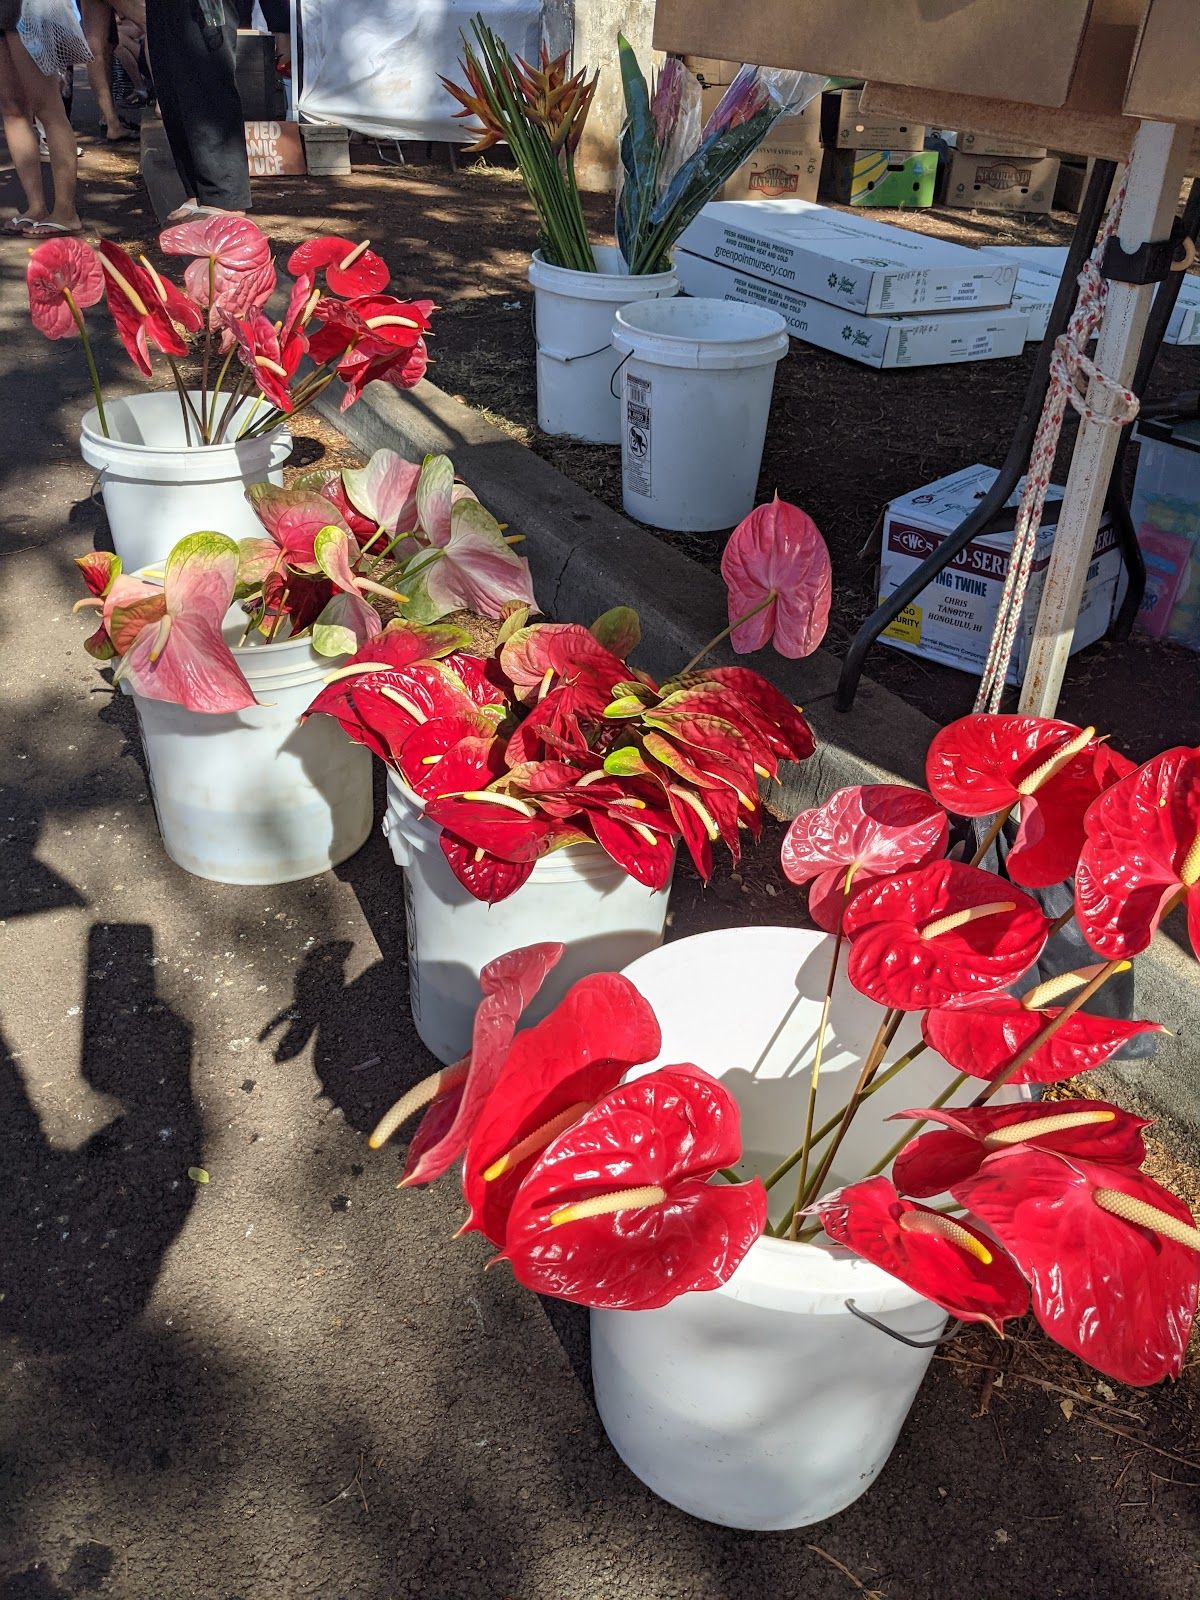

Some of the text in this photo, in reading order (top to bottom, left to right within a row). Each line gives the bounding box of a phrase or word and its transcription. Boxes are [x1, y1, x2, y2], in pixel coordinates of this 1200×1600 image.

[714, 246, 796, 280] greenpointnursery.com
[902, 533, 923, 550] CWC
[932, 570, 988, 597] ING TWINE
[944, 596, 968, 608] CHRIS
[937, 604, 975, 620] TANOUYE
